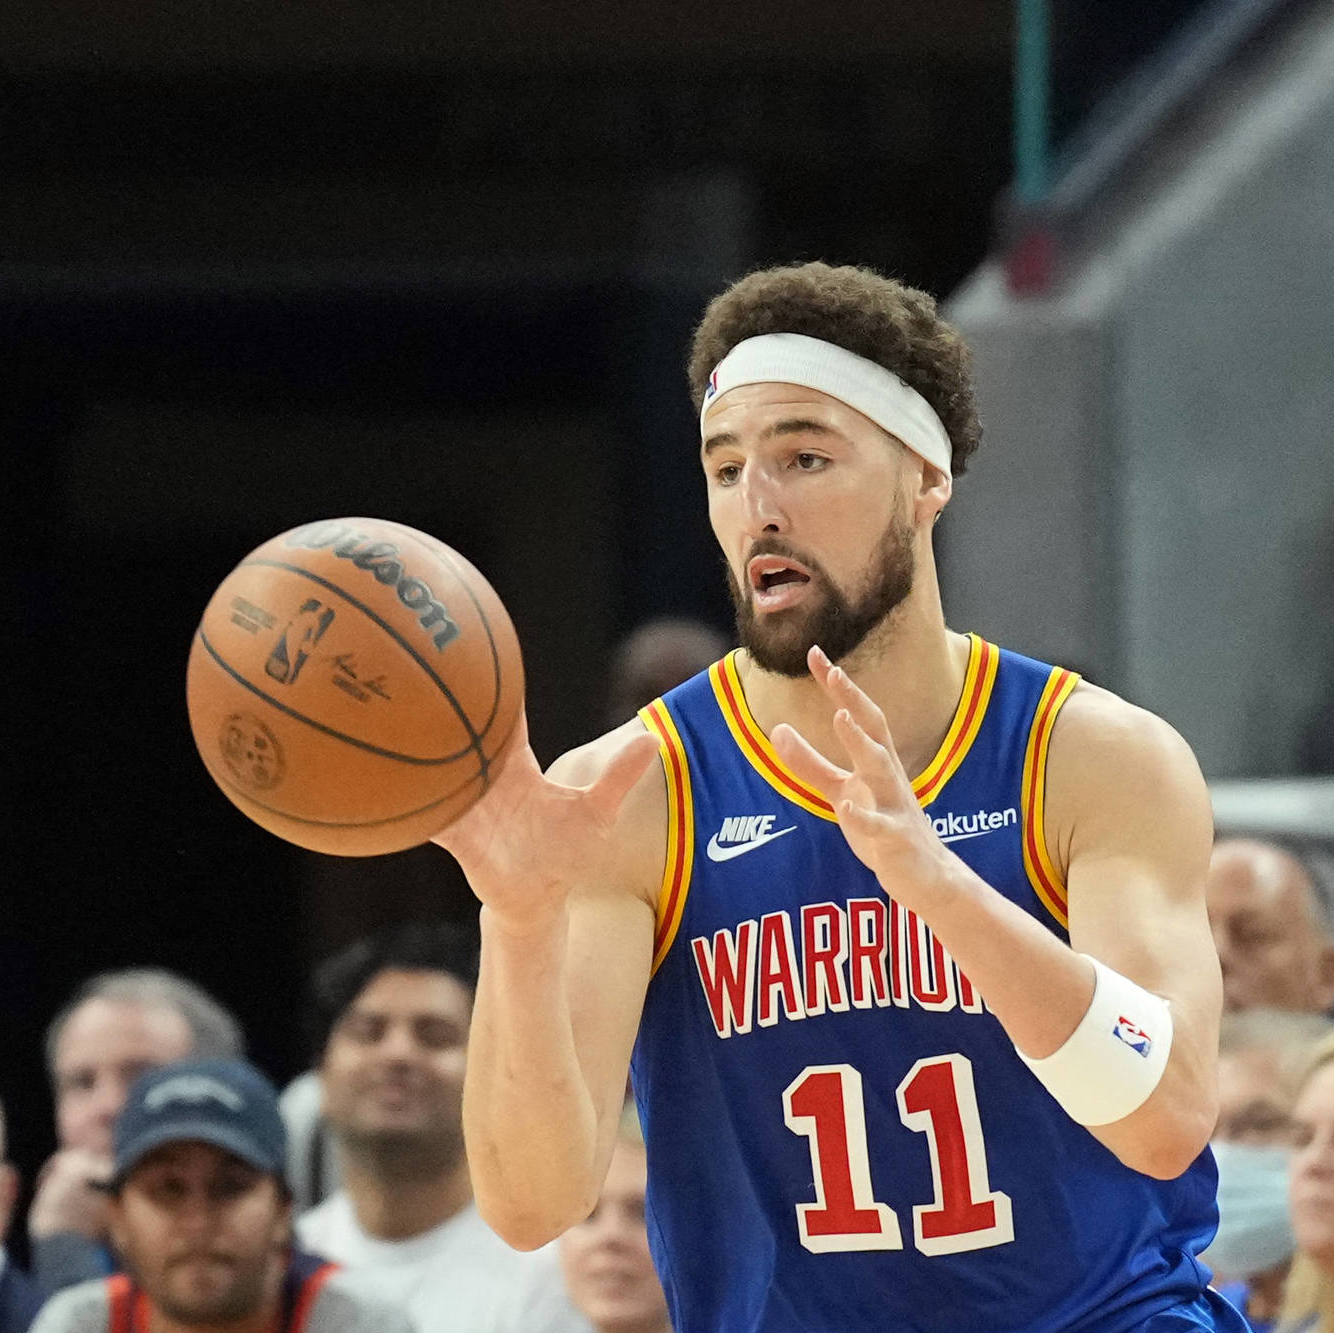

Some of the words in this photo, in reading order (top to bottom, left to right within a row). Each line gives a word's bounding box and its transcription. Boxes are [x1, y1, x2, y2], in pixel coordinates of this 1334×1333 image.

[717, 815, 776, 842] NIKE
[925, 808, 1017, 837] akuten
[782, 1053, 1015, 1257] 11
